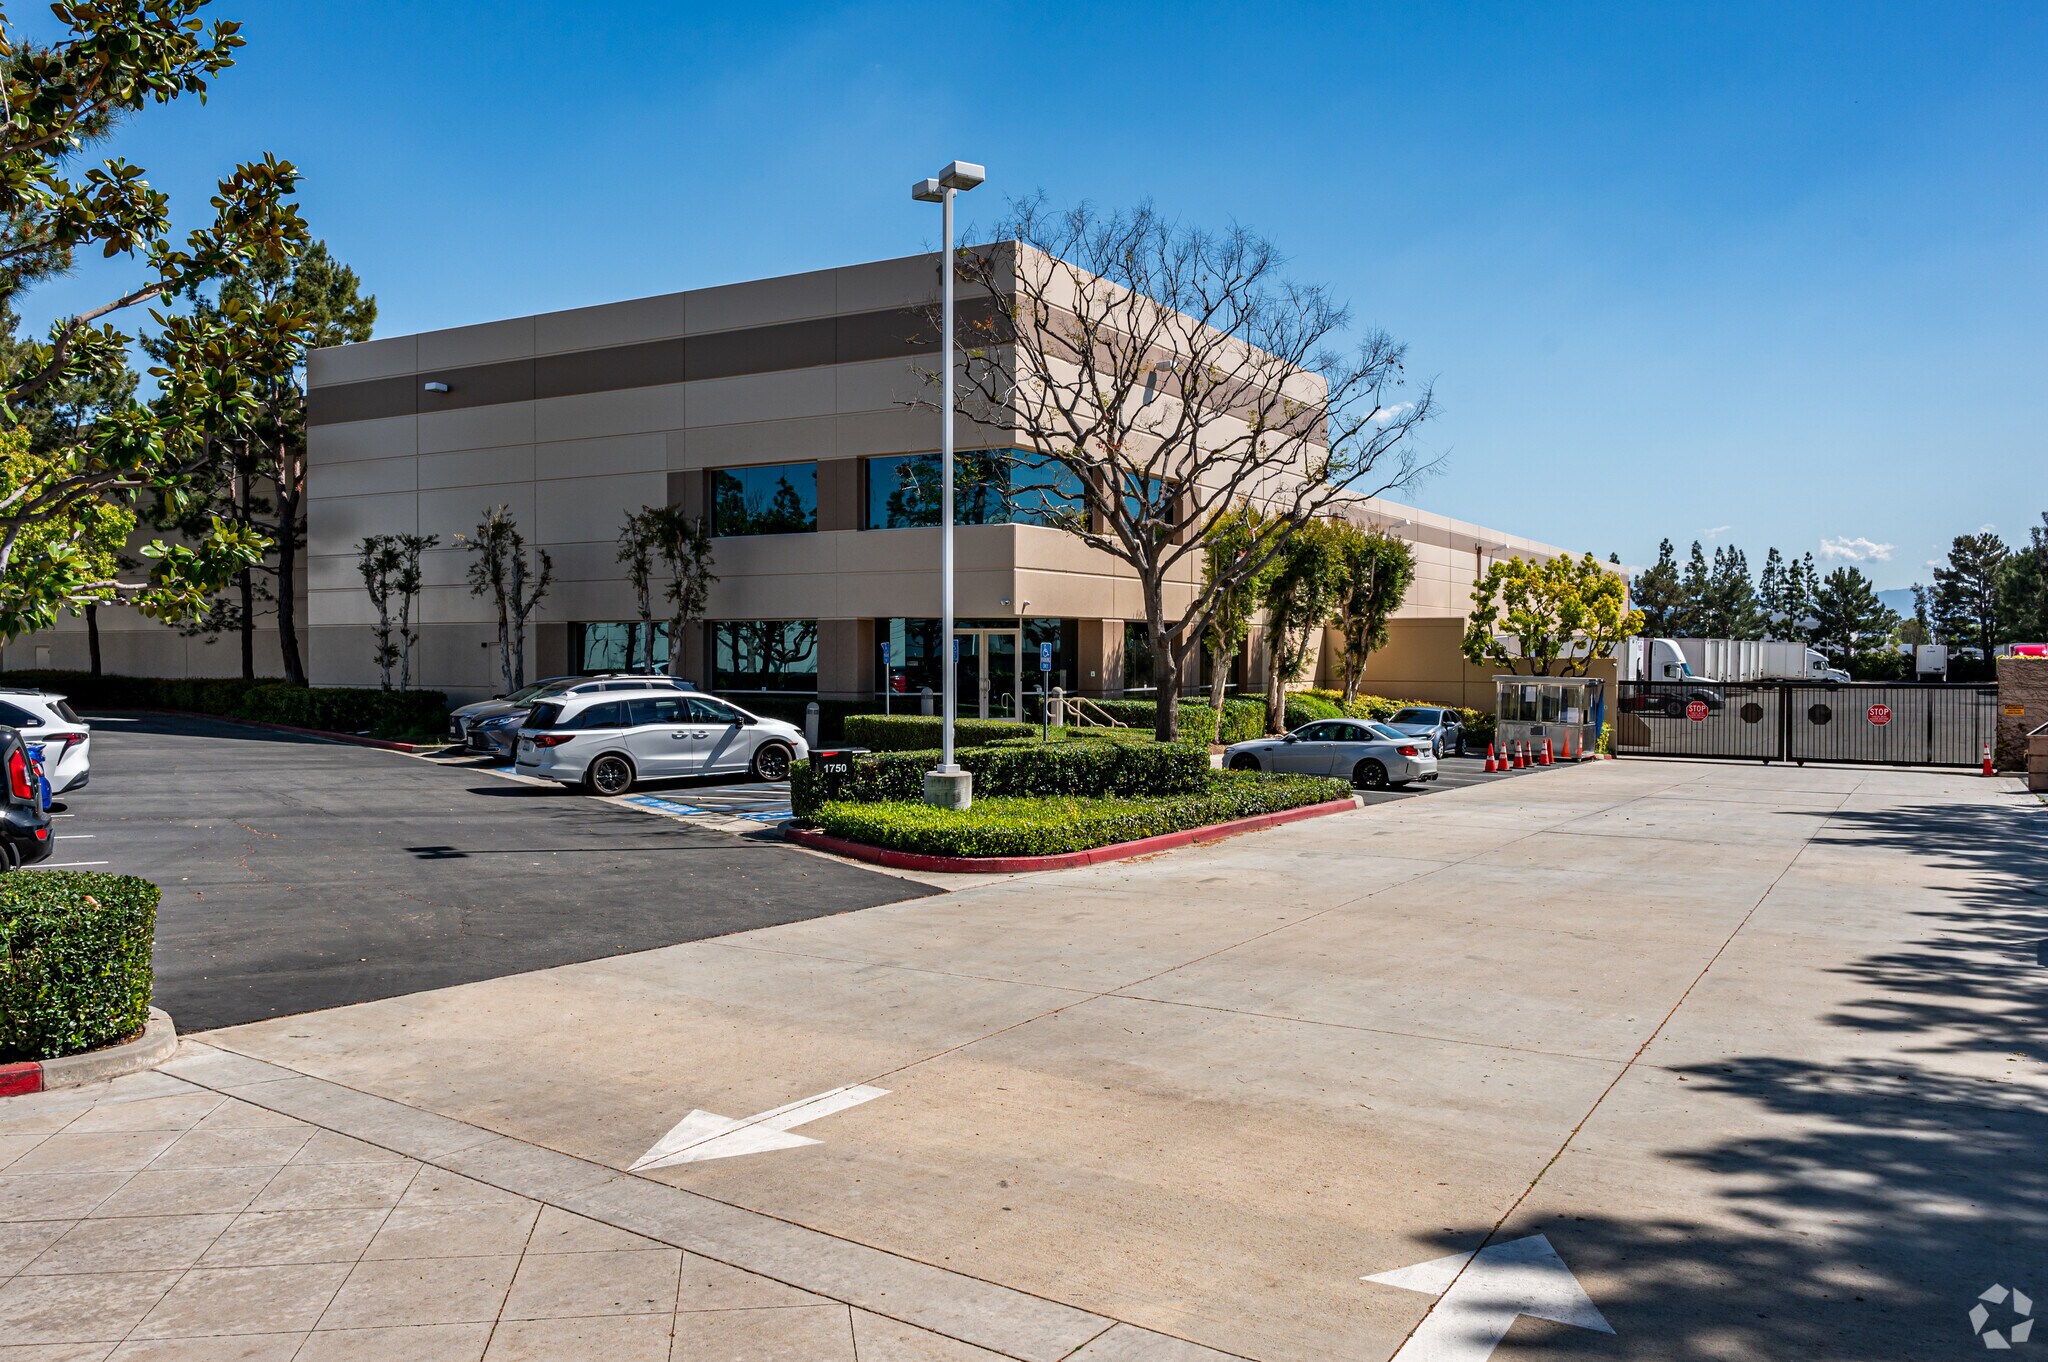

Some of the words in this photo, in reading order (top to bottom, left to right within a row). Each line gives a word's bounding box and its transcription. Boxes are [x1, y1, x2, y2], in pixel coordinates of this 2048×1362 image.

[1688, 704, 1706, 712] STOP
[1869, 708, 1889, 716] STOP
[823, 763, 847, 773] 1750
